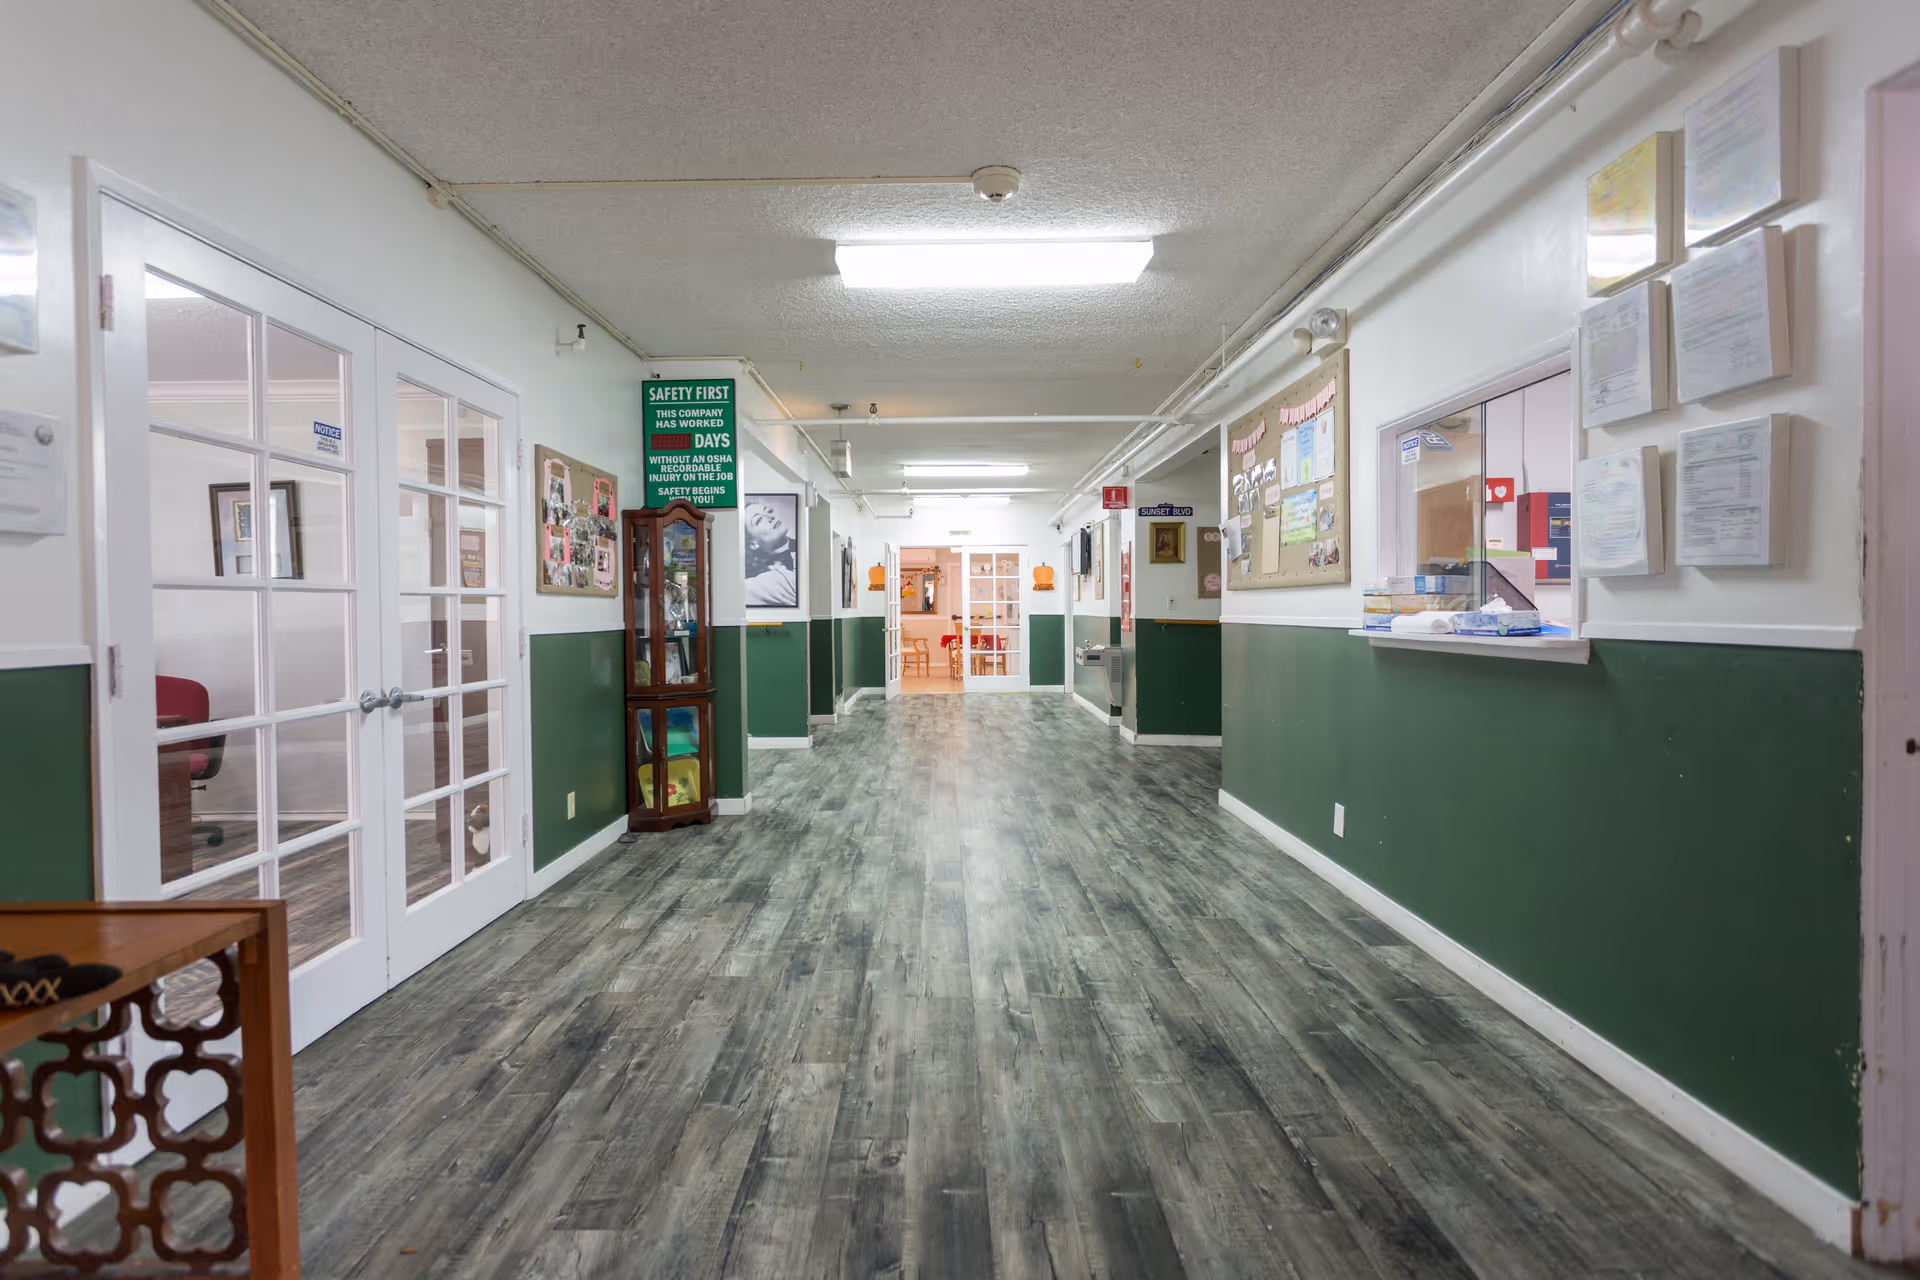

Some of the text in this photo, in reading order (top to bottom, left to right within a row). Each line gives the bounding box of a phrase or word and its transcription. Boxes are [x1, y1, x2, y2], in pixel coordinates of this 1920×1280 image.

[649, 385, 730, 401] SAFETY FIRST
[656, 408, 724, 418] THIS COMPANY
[656, 418, 724, 429] HAS WORKED
[315, 423, 340, 438] NOTICE
[694, 433, 731, 448] DAYS
[1403, 438, 1418, 448] NOTICE
[649, 454, 733, 464] WITHOUT AN OSHA
[660, 463, 722, 473] RECORDABLE
[649, 472, 733, 482] INJURY ON THE JOB
[658, 486, 726, 496] SAFETY BEGINS
[692, 495, 714, 504] YOU!
[1141, 507, 1191, 516] SUNSET BLVD
